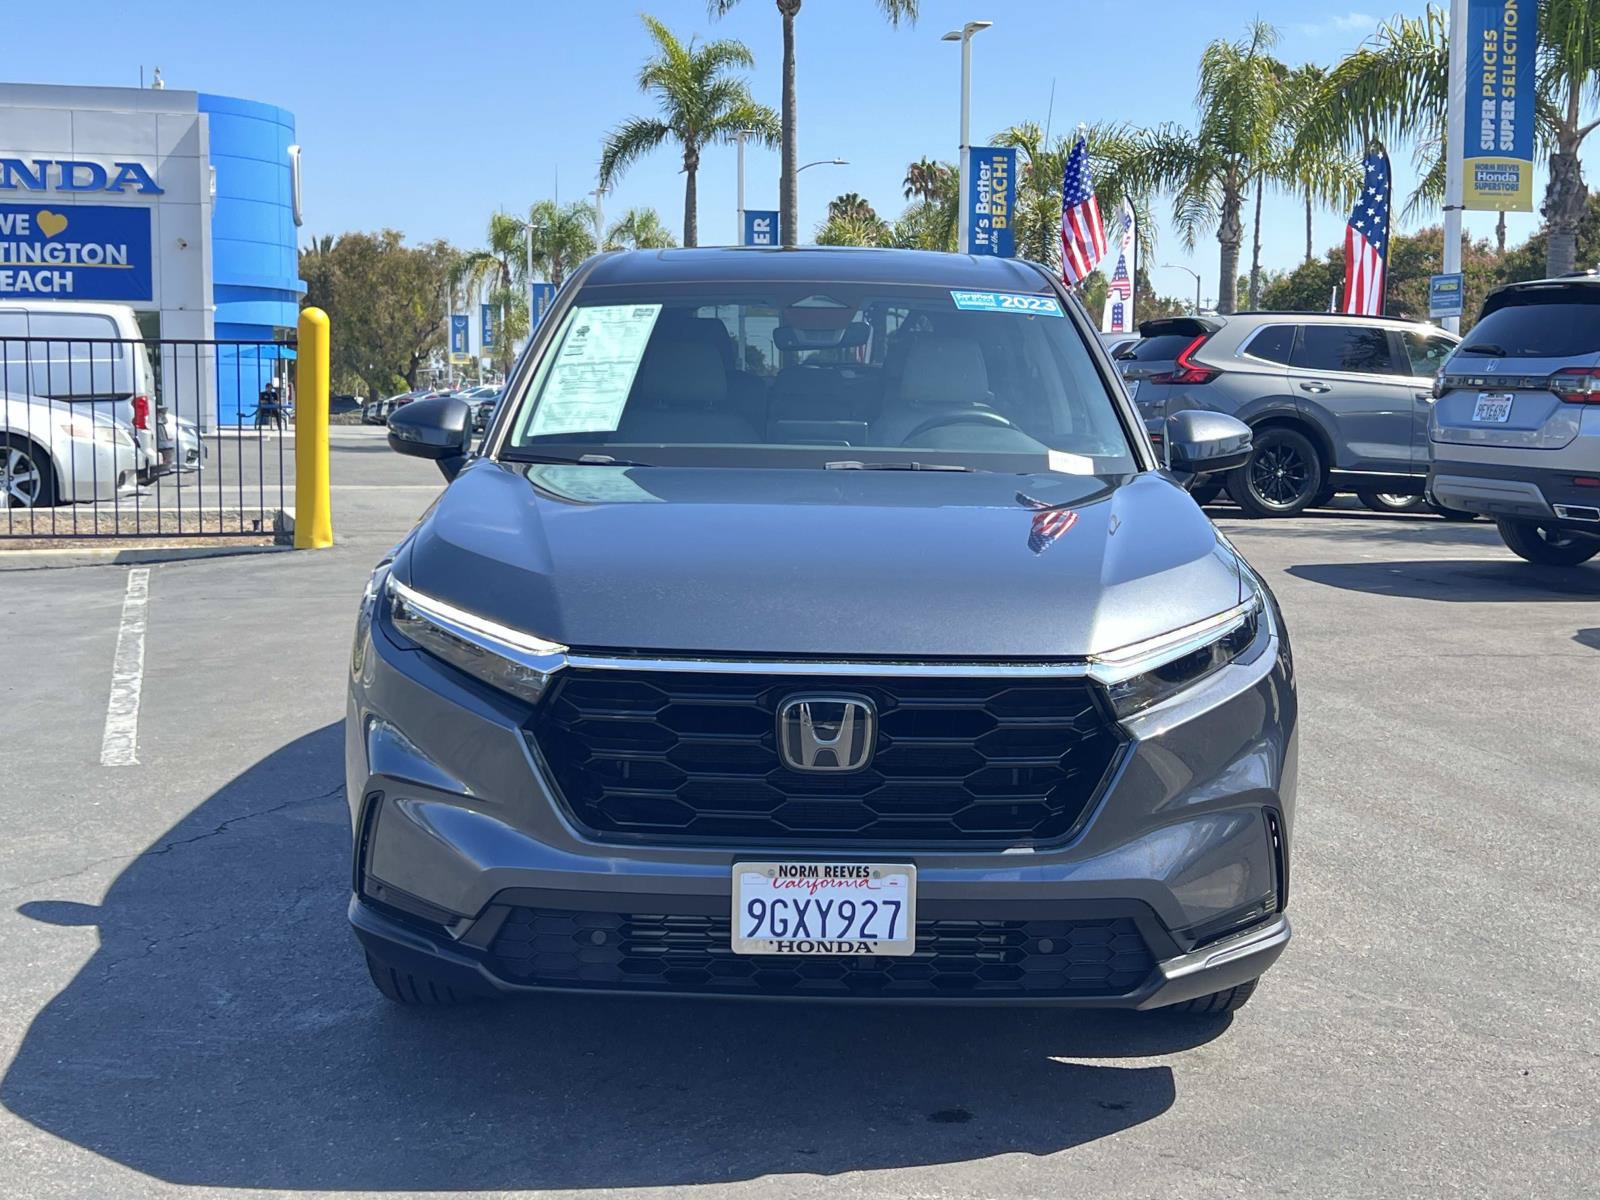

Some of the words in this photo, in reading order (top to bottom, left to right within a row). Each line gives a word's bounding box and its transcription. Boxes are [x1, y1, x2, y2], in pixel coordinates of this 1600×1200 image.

[1482, 29, 1498, 97] PRICES
[1480, 99, 1496, 151] SUPER
[1500, 99, 1516, 151] SUPER
[975, 160, 991, 214] Better
[1474, 182, 1520, 192] SUPERSTORE
[1477, 171, 1517, 182] Honda
[992, 156, 1008, 229] BEACH!
[975, 218, 990, 245] It's
[998, 295, 1057, 311] 2023
[779, 865, 819, 878] NORM
[824, 865, 870, 878] REEVES
[772, 877, 881, 895] California
[747, 898, 901, 939] 9GXY927
[776, 941, 875, 954] HONDA
